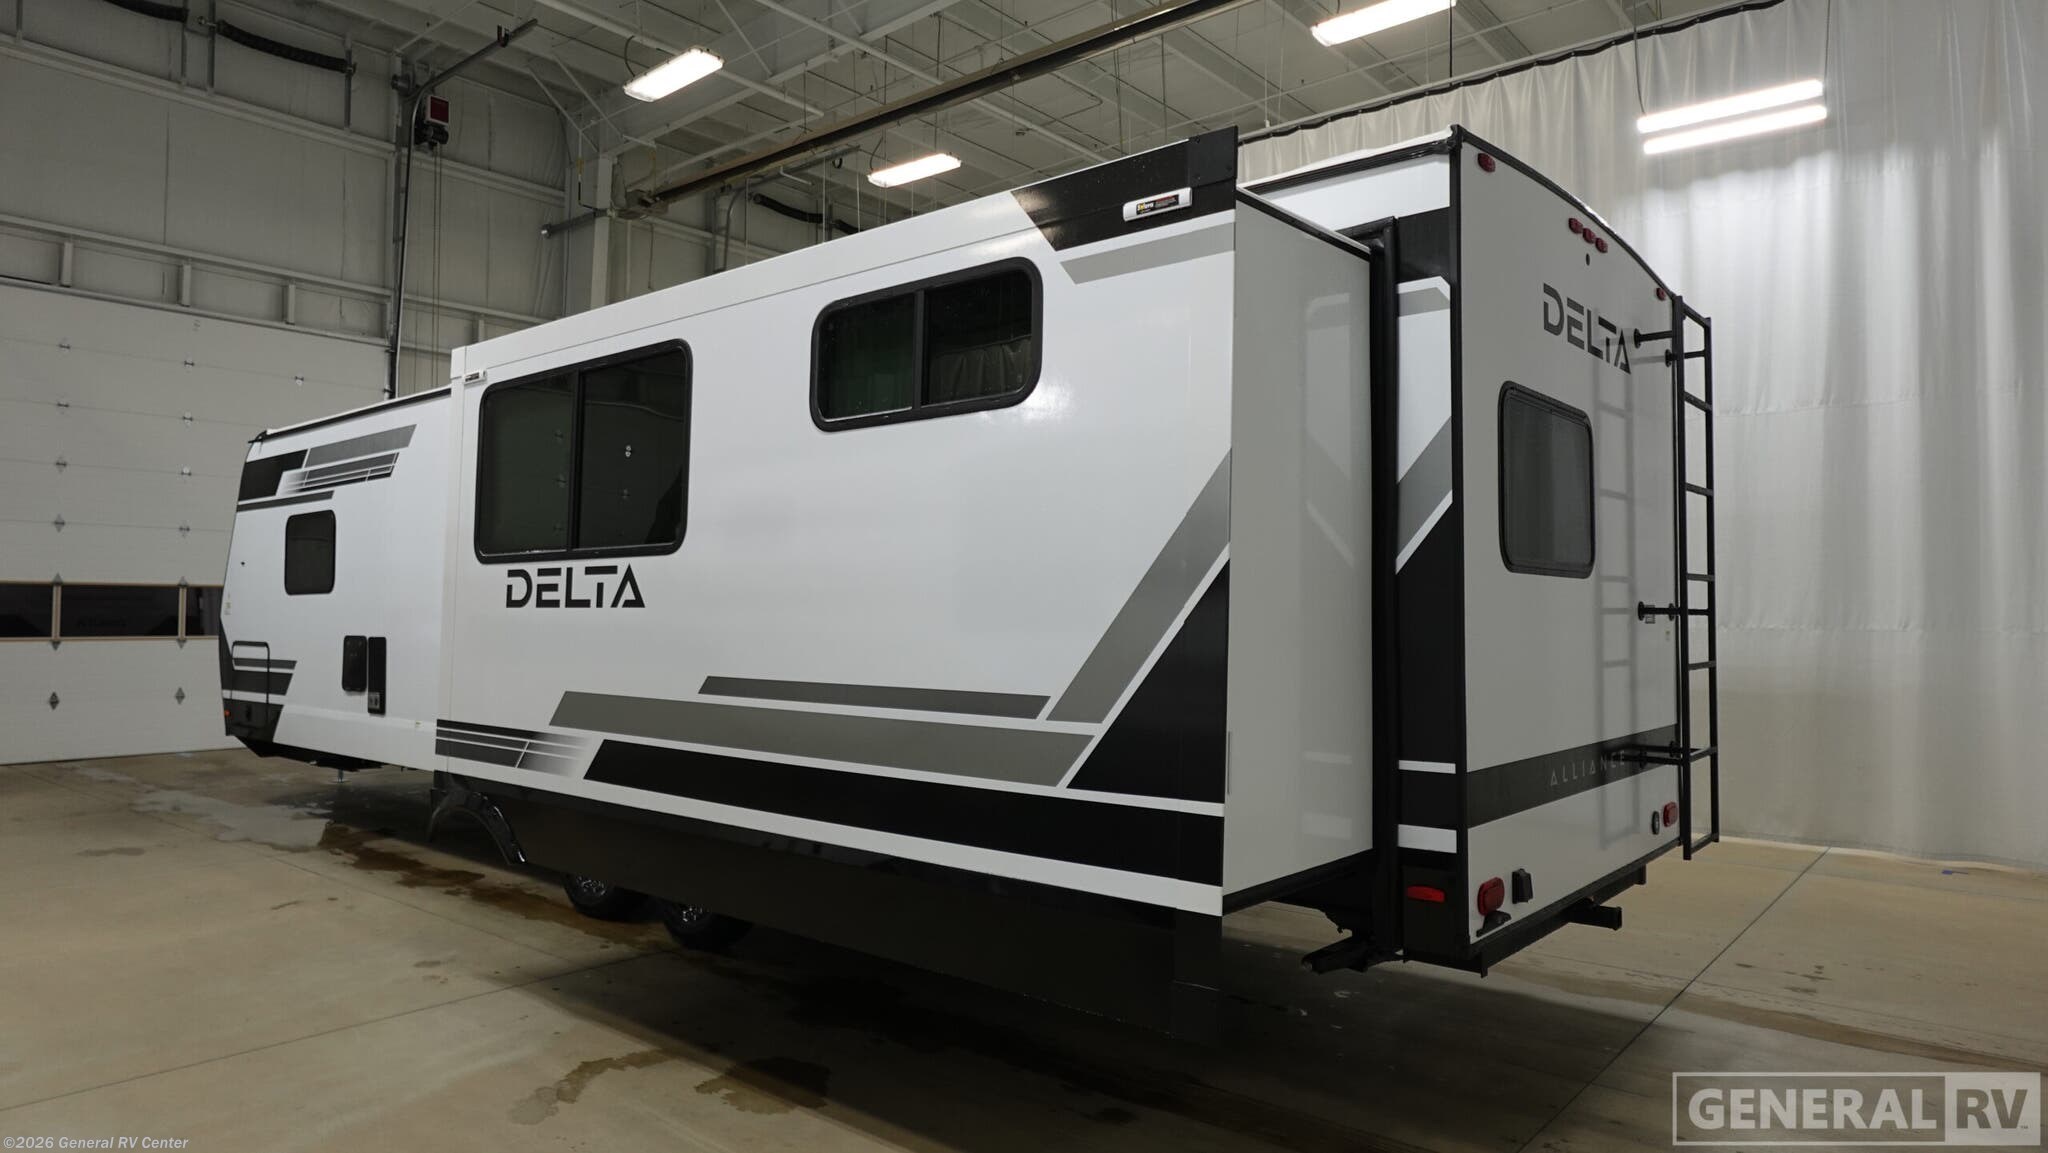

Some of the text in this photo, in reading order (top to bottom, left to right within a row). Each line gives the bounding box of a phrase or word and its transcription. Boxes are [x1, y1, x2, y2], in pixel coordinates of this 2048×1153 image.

[1543, 282, 1631, 375] DELTA
[506, 563, 646, 608] DELTA
[1550, 750, 1625, 786] ALLIANCE
